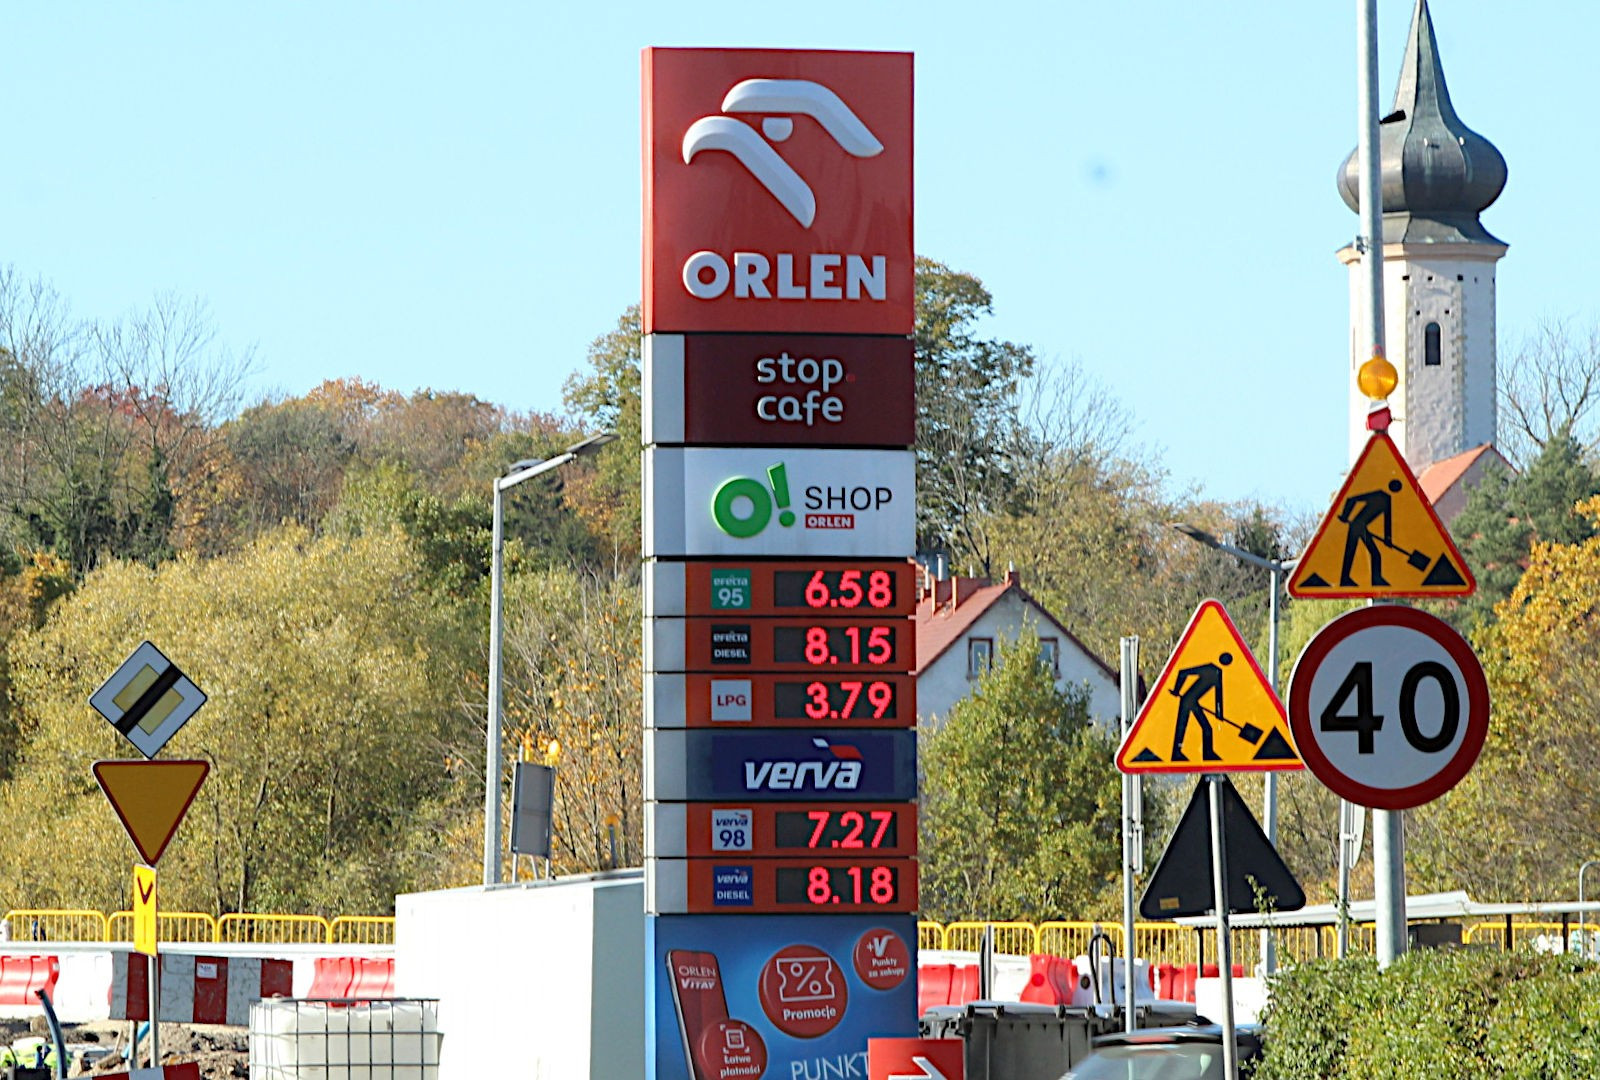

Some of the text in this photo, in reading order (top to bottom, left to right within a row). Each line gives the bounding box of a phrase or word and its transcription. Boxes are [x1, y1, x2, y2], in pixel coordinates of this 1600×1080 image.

[682, 250, 887, 301] ORLEN
[756, 352, 844, 393] stop
[756, 390, 844, 426] cafe
[805, 486, 893, 511] SHOP
[807, 515, 851, 528] ORLEN
[718, 587, 744, 607] 95
[804, 569, 893, 609] 6.58
[714, 648, 748, 659] DIESEL
[804, 625, 893, 665] 8.15
[717, 694, 747, 707] LPG
[804, 681, 893, 720] 3.79
[1319, 660, 1460, 755] 40
[744, 761, 862, 790] verva
[716, 818, 748, 827] verva
[807, 810, 892, 849] 7.27
[719, 829, 746, 848] 98
[716, 874, 749, 885] verva
[806, 865, 895, 905] 8.18
[716, 890, 750, 901] DIESEL
[678, 965, 717, 977] ORLEN
[871, 957, 898, 968] Punkty
[782, 1004, 837, 1021] Promocje
[724, 1054, 752, 1065] Łatwe
